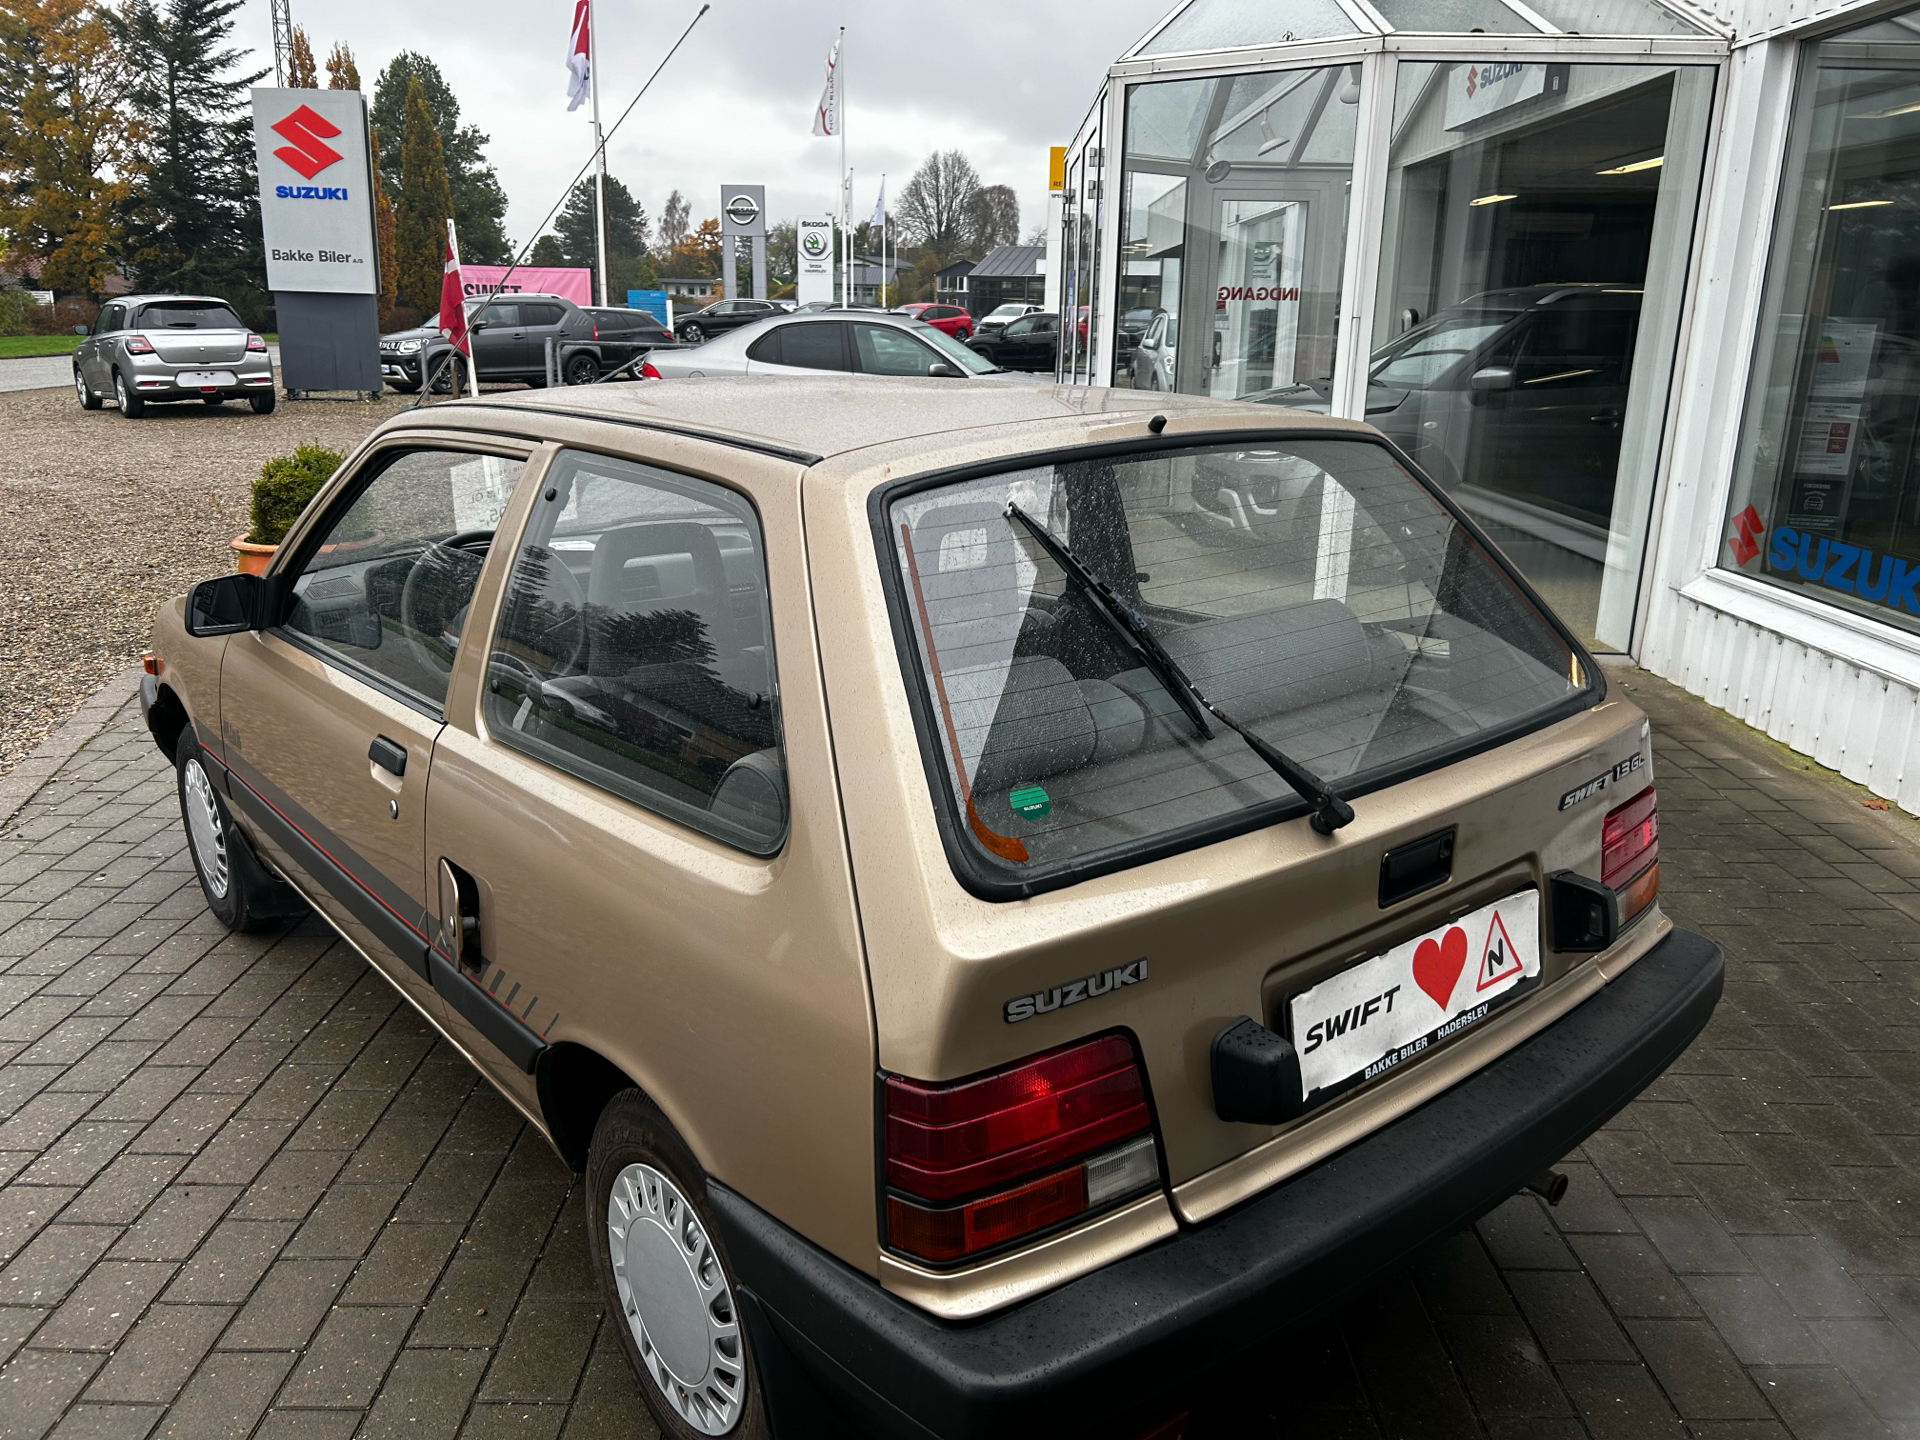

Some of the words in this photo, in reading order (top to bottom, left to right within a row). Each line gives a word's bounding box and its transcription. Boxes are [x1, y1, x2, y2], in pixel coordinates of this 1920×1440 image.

[275, 185, 348, 200] SUZUKI
[272, 249, 314, 262] Bakke
[319, 250, 351, 263] Biler
[1769, 526, 1920, 615] SUZUK
[1559, 770, 1613, 811] SWIFT
[1003, 957, 1148, 1024] SUZUKI
[1304, 985, 1400, 1055] SWIFT
[1364, 1054, 1398, 1080] BAKKE
[1400, 1037, 1428, 1060] BILER
[1437, 1003, 1488, 1040] HADERSLEV
